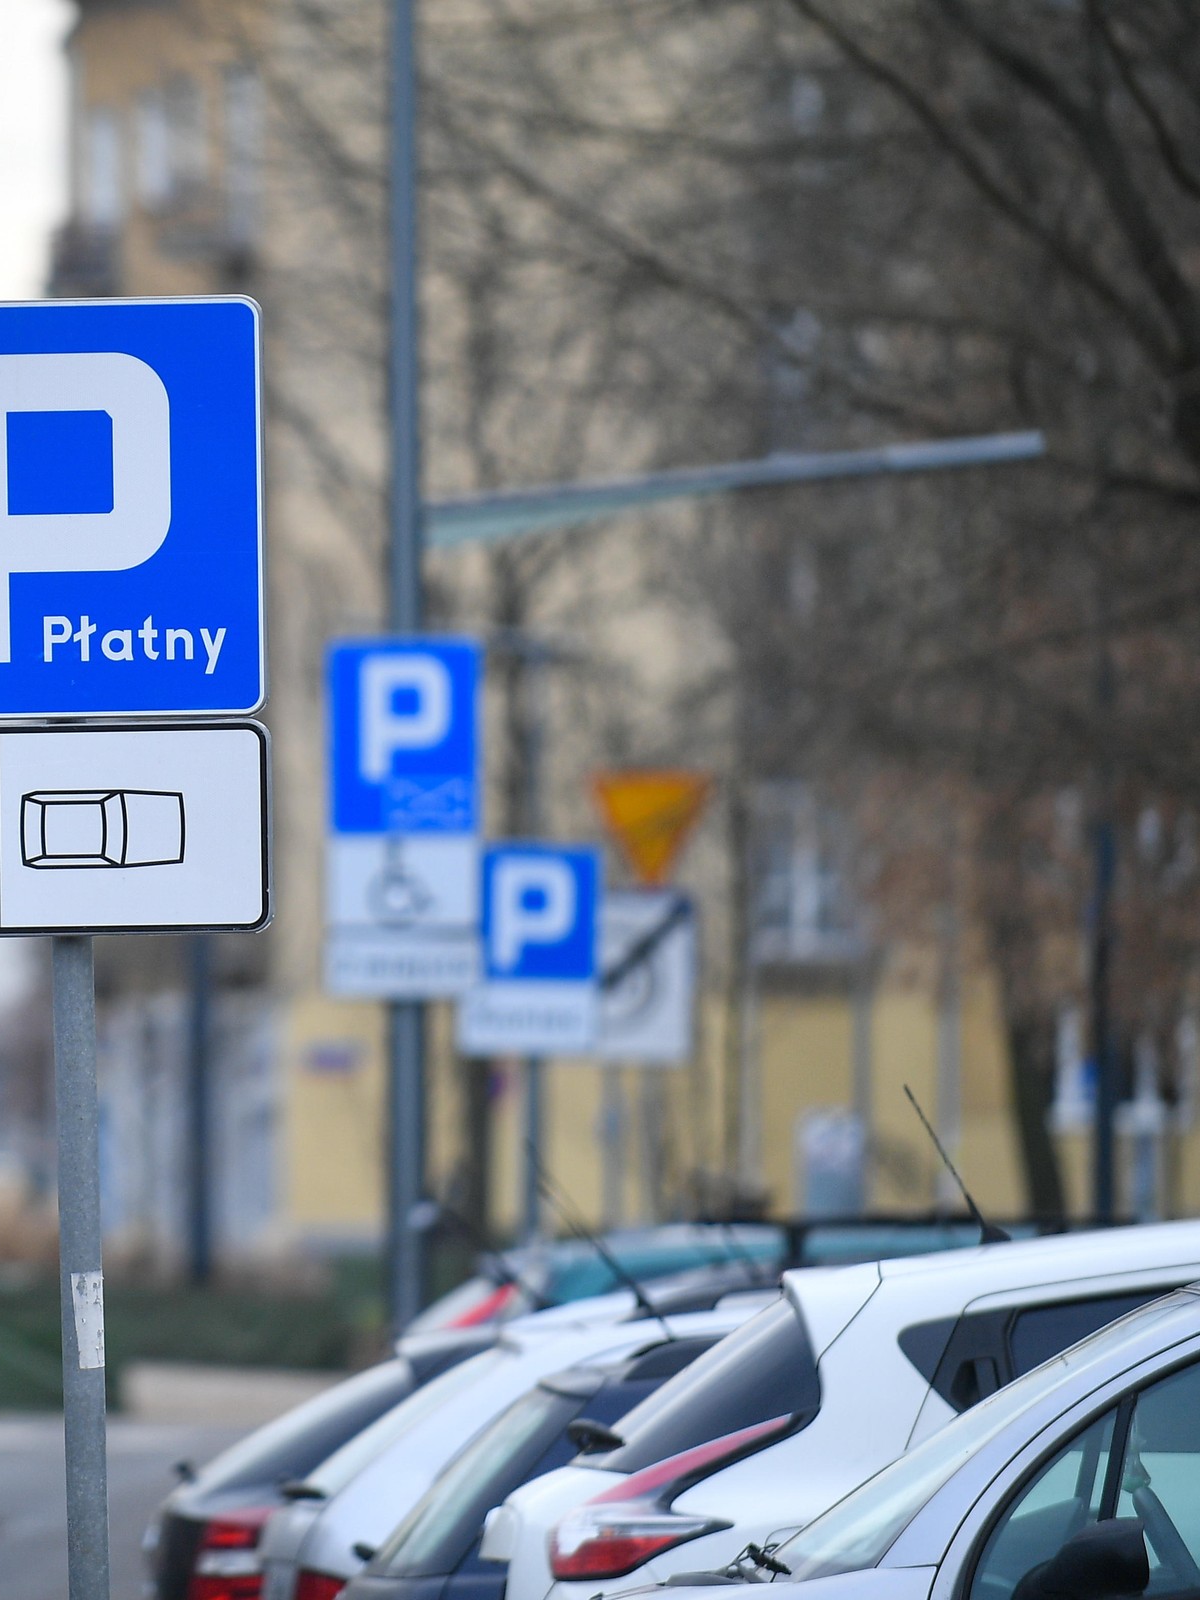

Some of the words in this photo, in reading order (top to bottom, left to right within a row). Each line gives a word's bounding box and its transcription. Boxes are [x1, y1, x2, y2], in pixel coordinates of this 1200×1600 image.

[43, 614, 227, 675] Płatny
[358, 653, 452, 783] P
[490, 855, 577, 970] P
